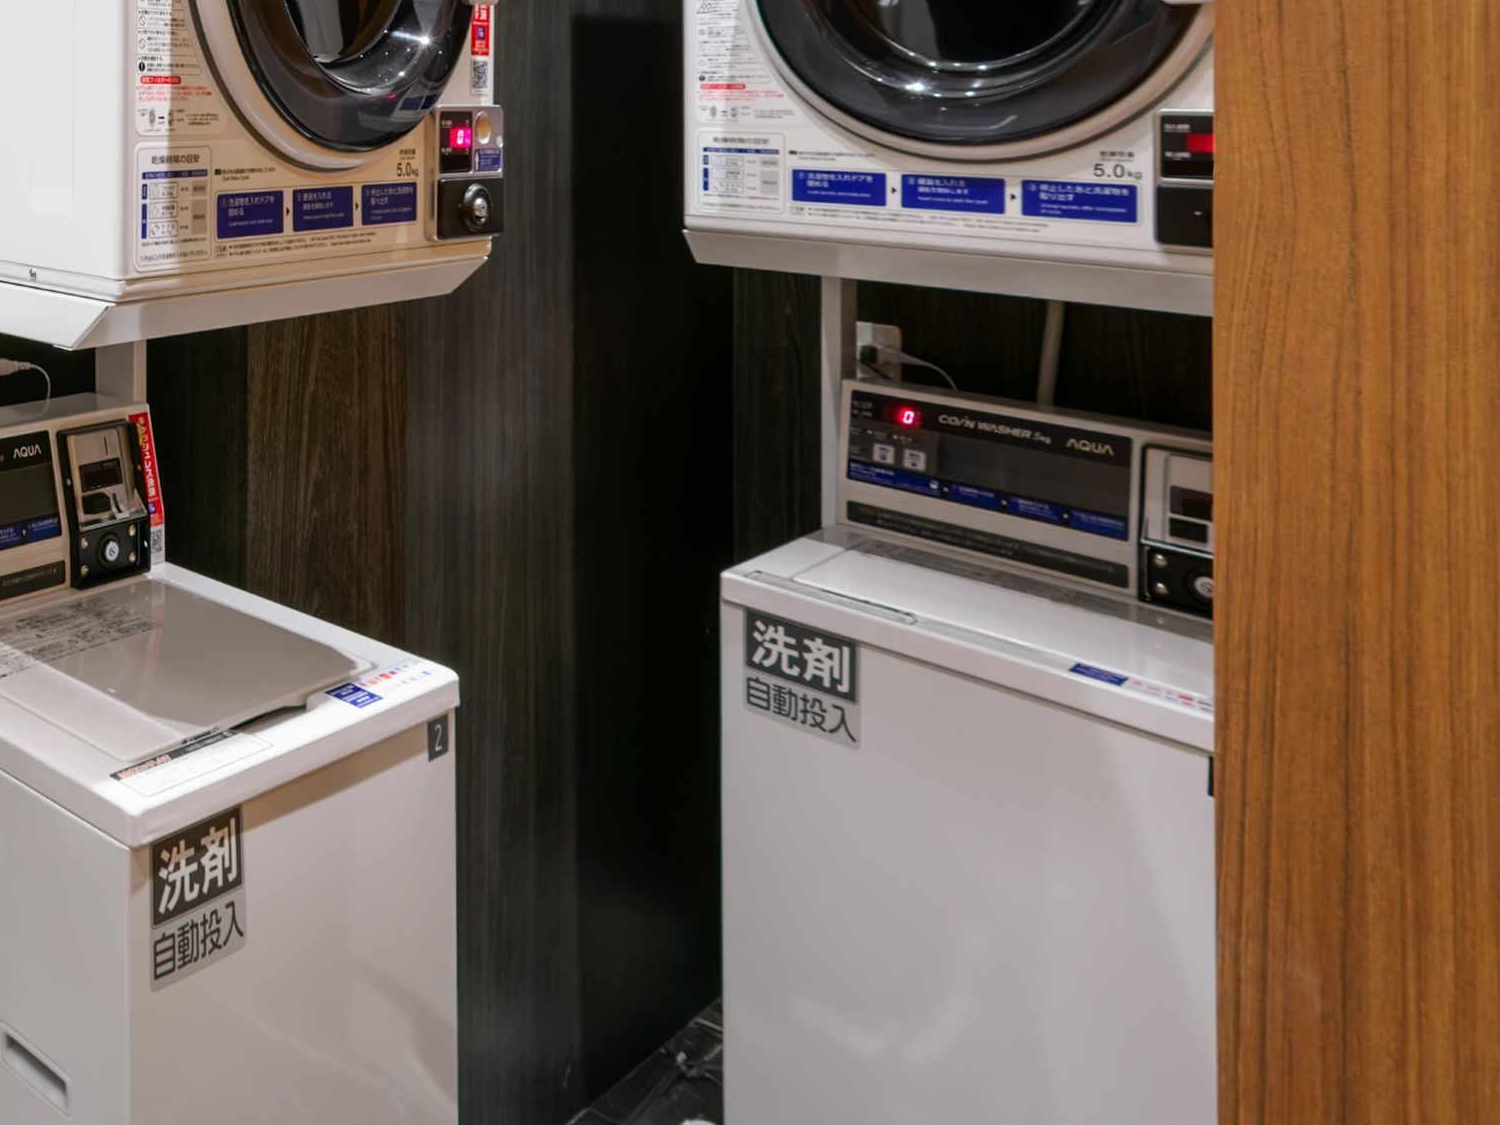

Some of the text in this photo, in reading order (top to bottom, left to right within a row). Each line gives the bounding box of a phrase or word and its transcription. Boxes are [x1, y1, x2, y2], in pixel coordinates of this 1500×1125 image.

[903, 411, 914, 425] 0
[977, 421, 1033, 441] WASHER
[13, 444, 42, 459] AQUA
[1066, 438, 1115, 457] AQUA
[752, 619, 851, 693] 洗剤
[746, 676, 857, 743] 自動投入
[434, 723, 443, 752] 2
[158, 817, 240, 914] 洗剤
[153, 900, 245, 981] 自動投入
